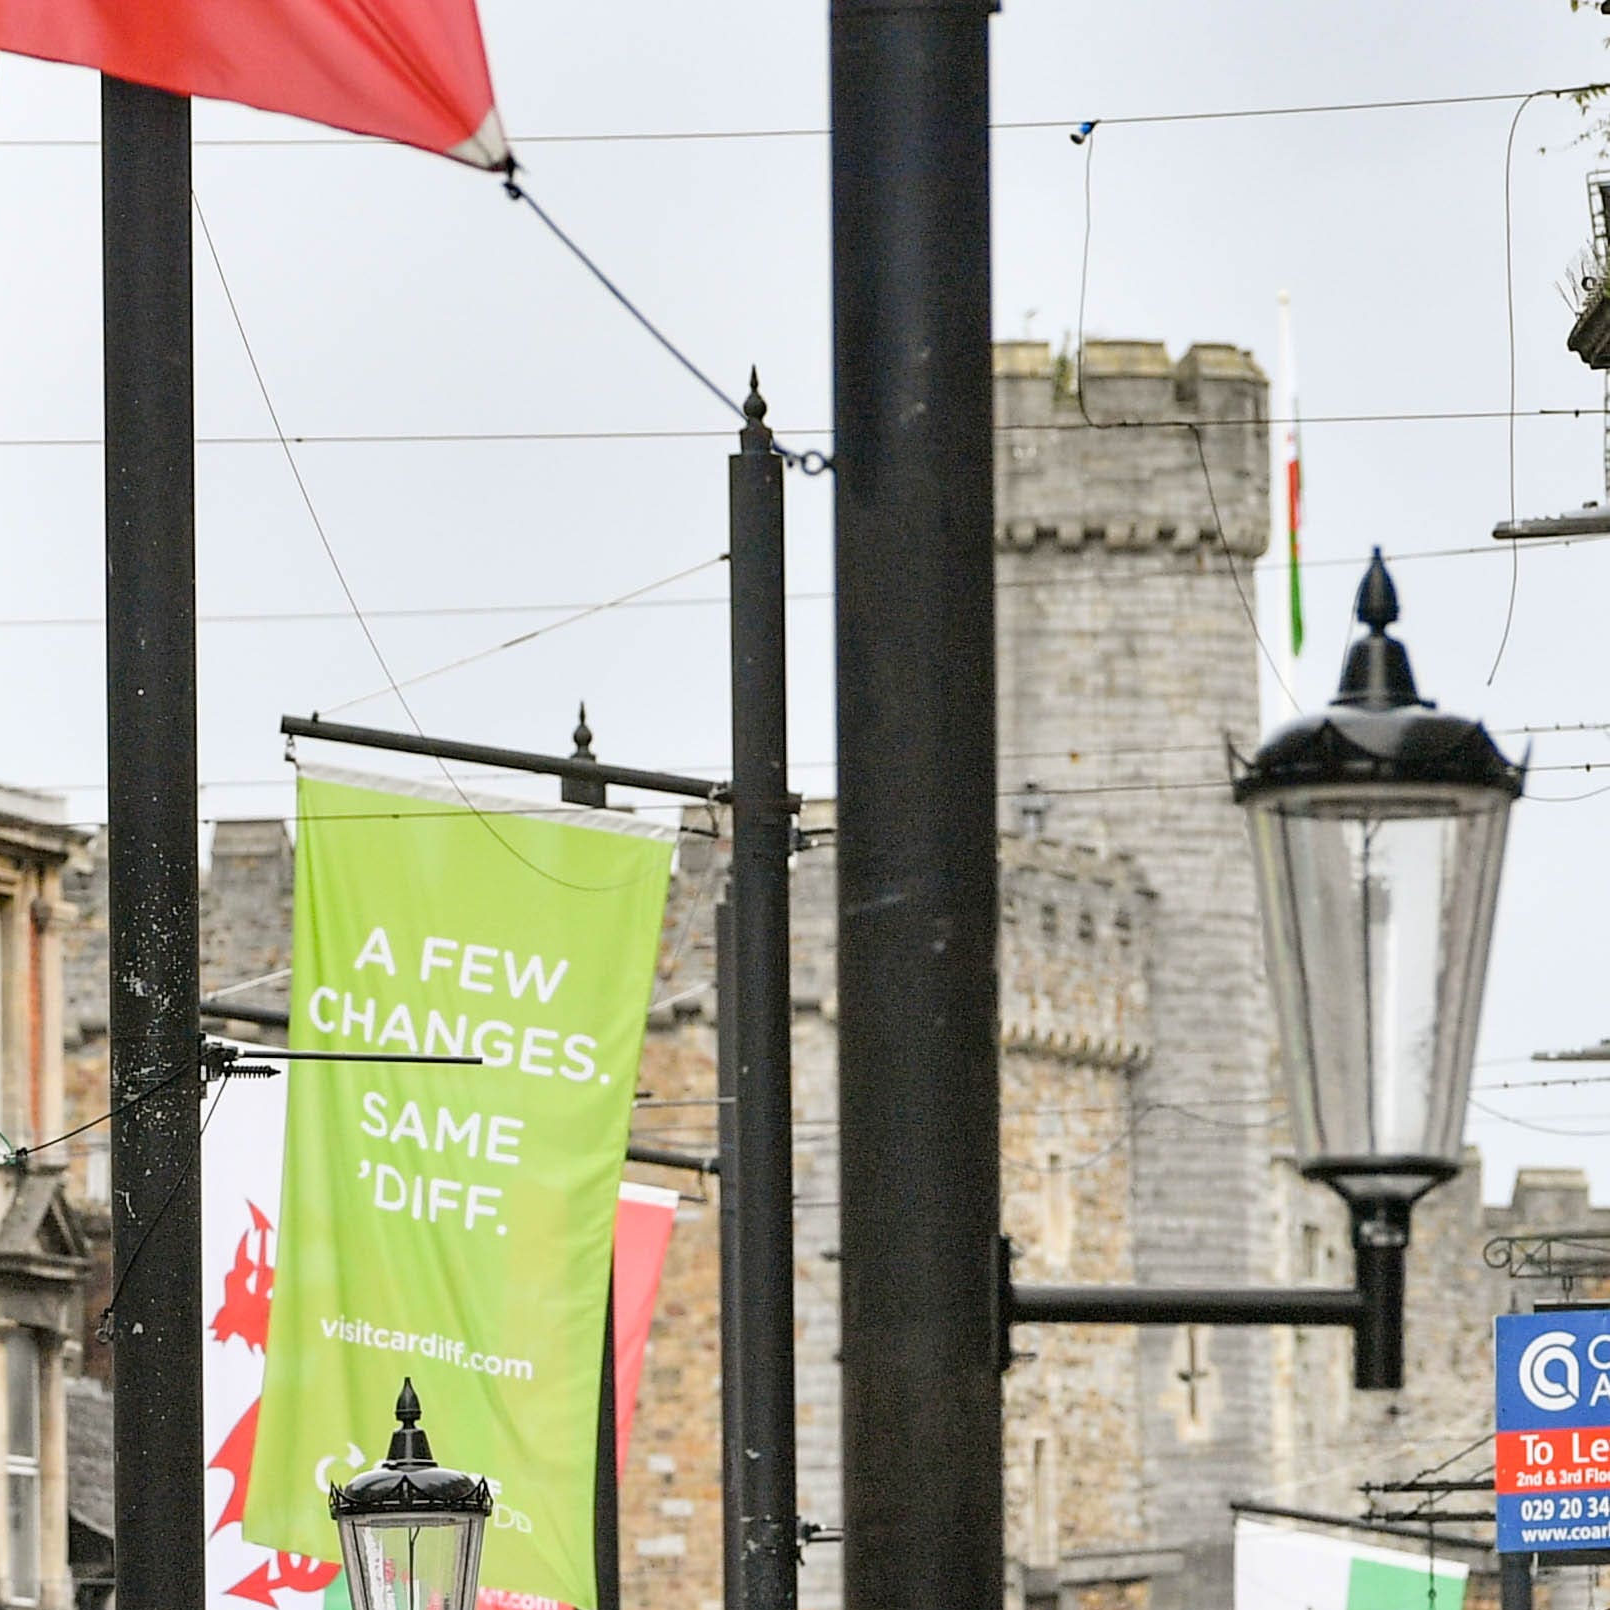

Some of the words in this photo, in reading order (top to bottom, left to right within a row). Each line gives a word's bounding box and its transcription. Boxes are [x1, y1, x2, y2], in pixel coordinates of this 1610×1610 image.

[355, 926, 395, 977] A
[420, 936, 569, 1004] FEW
[308, 985, 611, 1085] CHANGES.
[360, 1091, 525, 1165] SAME
[358, 1159, 508, 1237] 'DIFF.
[320, 1314, 535, 1381] visitcardiff.com
[1516, 1471, 1542, 1488] 2nd
[1545, 1470, 1557, 1486] &
[1559, 1469, 1583, 1484] 3rd
[1520, 1433, 1554, 1466] To
[1572, 1432, 1610, 1464] Le
[1521, 1499, 1555, 1522] 029
[1559, 1498, 1583, 1520] 20
[1521, 1524, 1610, 1543] www.coar
